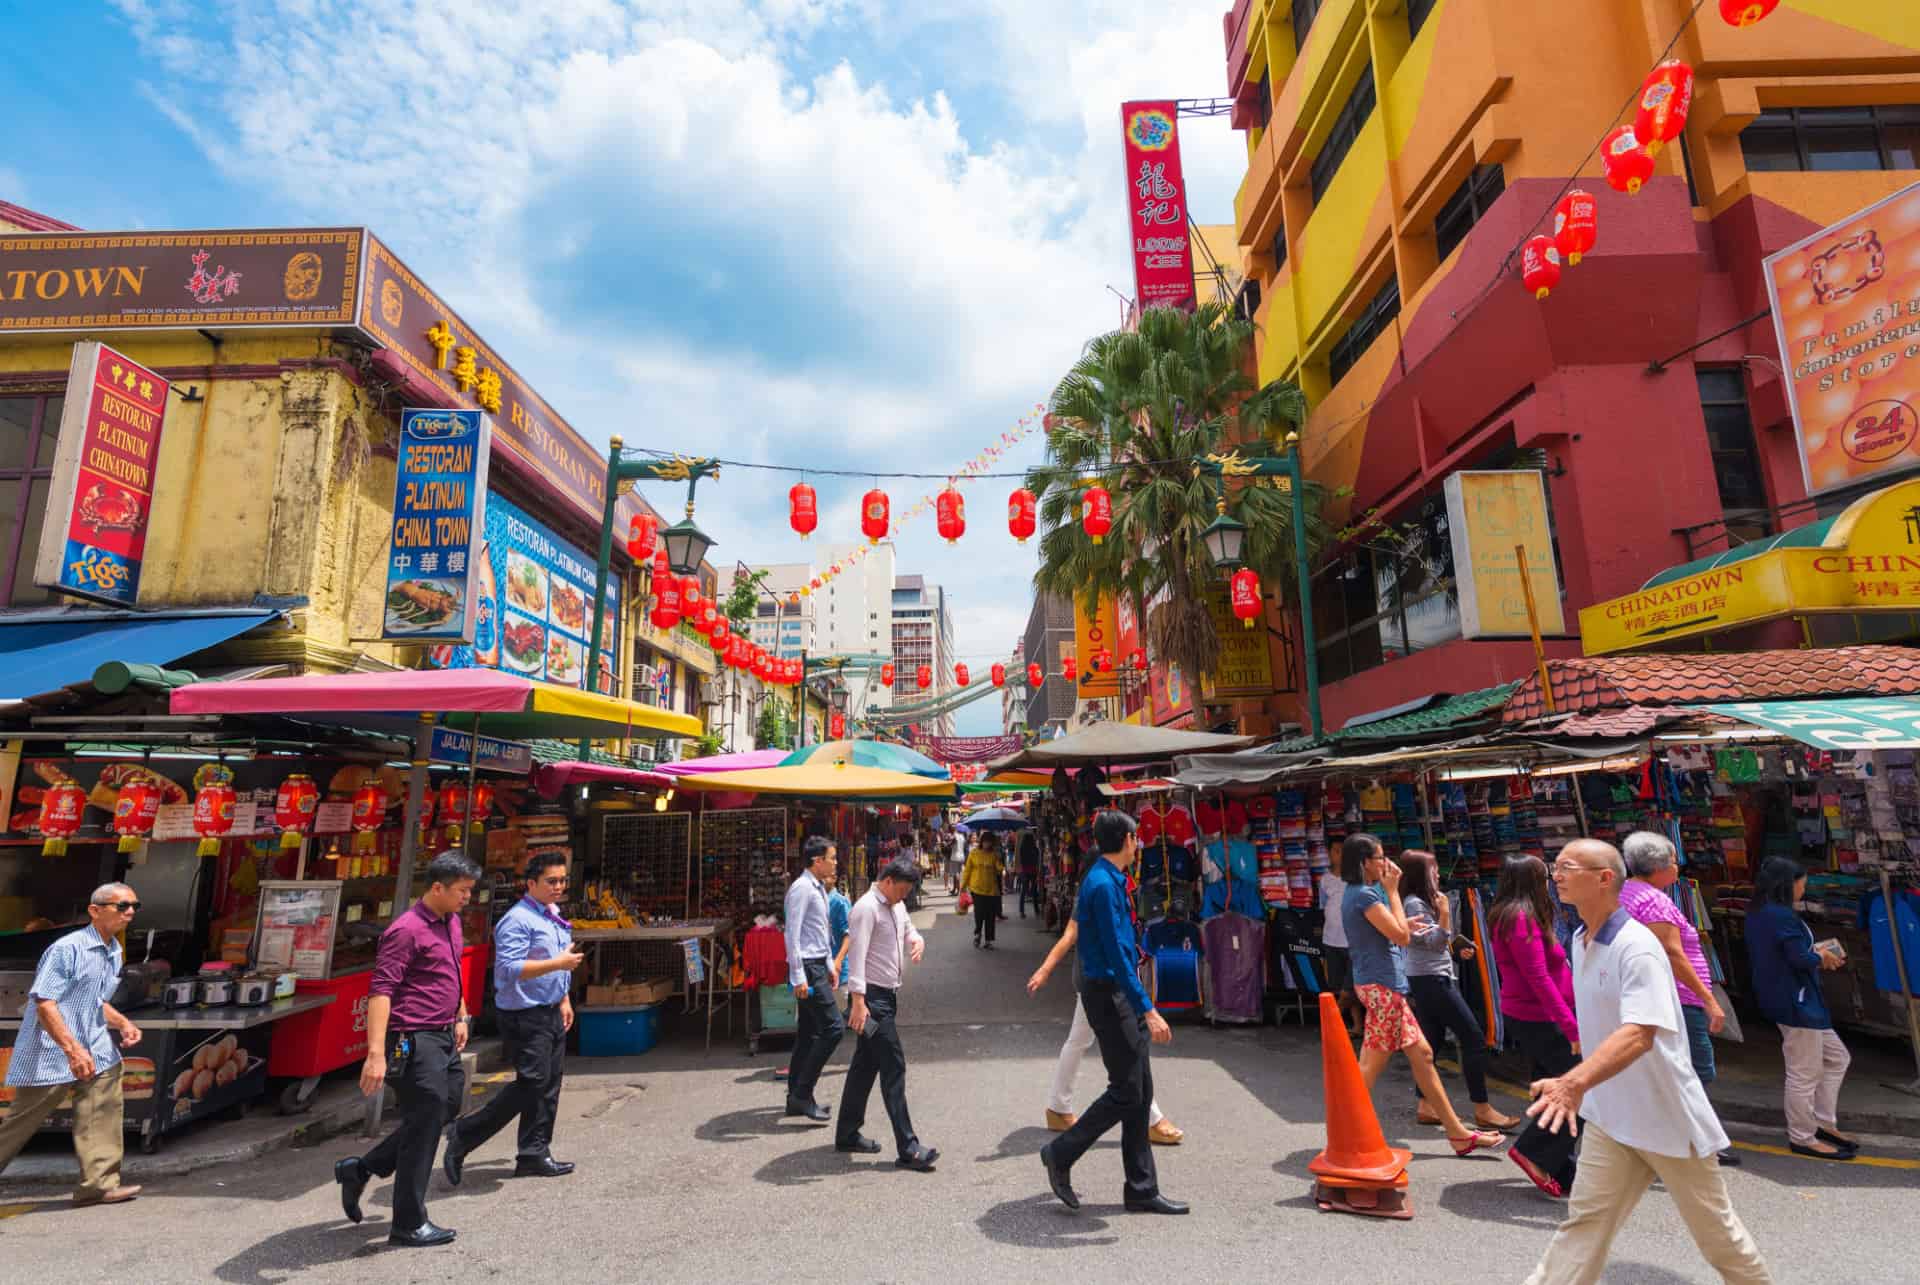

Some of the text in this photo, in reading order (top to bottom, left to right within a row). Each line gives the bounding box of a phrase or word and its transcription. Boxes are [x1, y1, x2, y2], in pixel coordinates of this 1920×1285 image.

[1136, 160, 1180, 225] 龍記
[1144, 254, 1183, 269] KEE
[0, 266, 148, 301] TOWN
[102, 393, 153, 433] RESTORAN
[1854, 406, 1904, 441] 24
[97, 421, 149, 460] PLATINUM
[511, 400, 587, 489] RESTORAN
[89, 447, 149, 489] CHINATOWN
[404, 445, 472, 474] RESTORAN
[403, 480, 466, 511] PLATINUM
[394, 515, 470, 548] CHINA TOWN
[506, 515, 550, 561] RESTORAN
[550, 548, 582, 581] PLATINUM
[394, 551, 466, 573] 中華樓
[1605, 566, 1745, 619] CHINATOWN
[440, 733, 474, 753] JALAN
[1288, 943, 1321, 956] Emirates
